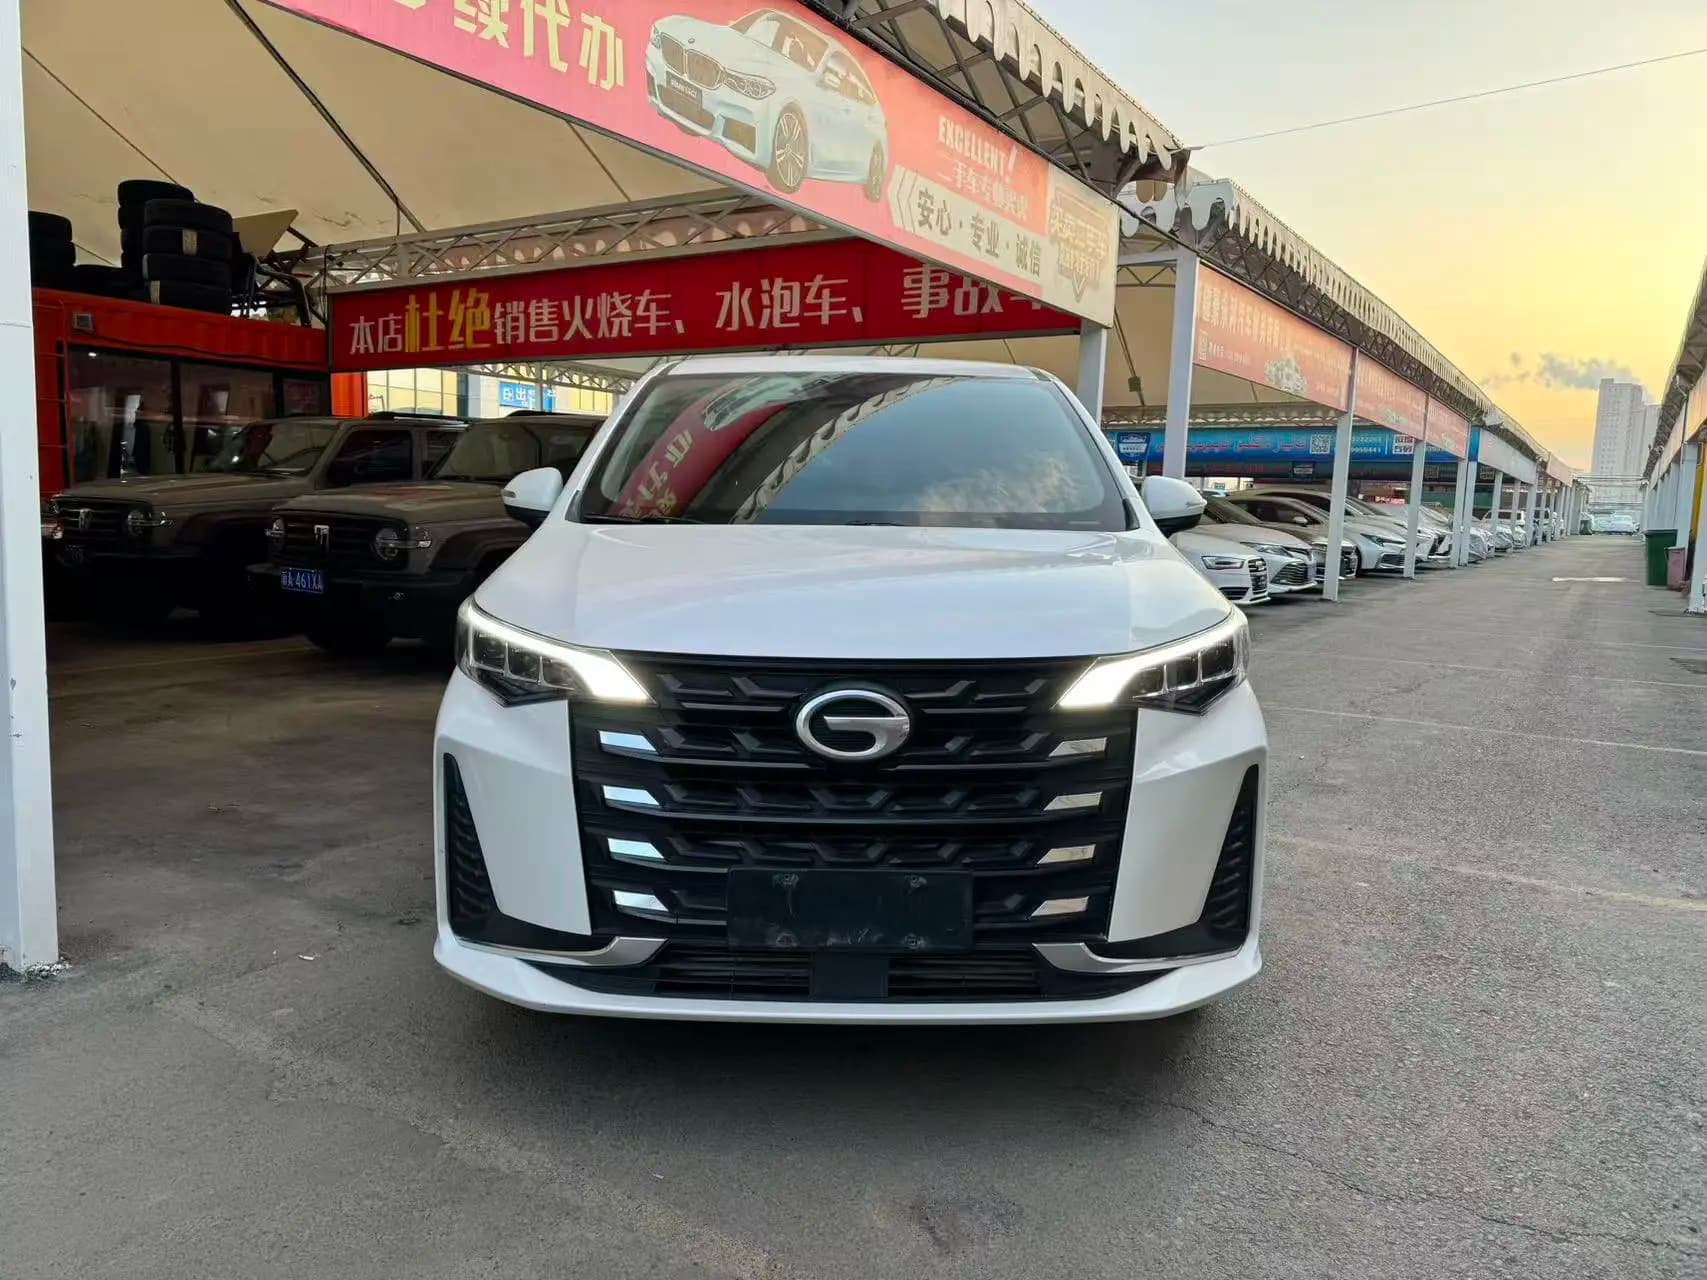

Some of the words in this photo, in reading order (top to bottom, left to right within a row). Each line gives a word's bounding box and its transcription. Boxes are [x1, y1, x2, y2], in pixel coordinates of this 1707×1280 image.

[391, 0, 625, 91] 续代办
[917, 187, 1042, 277] 安心·专业·诚信
